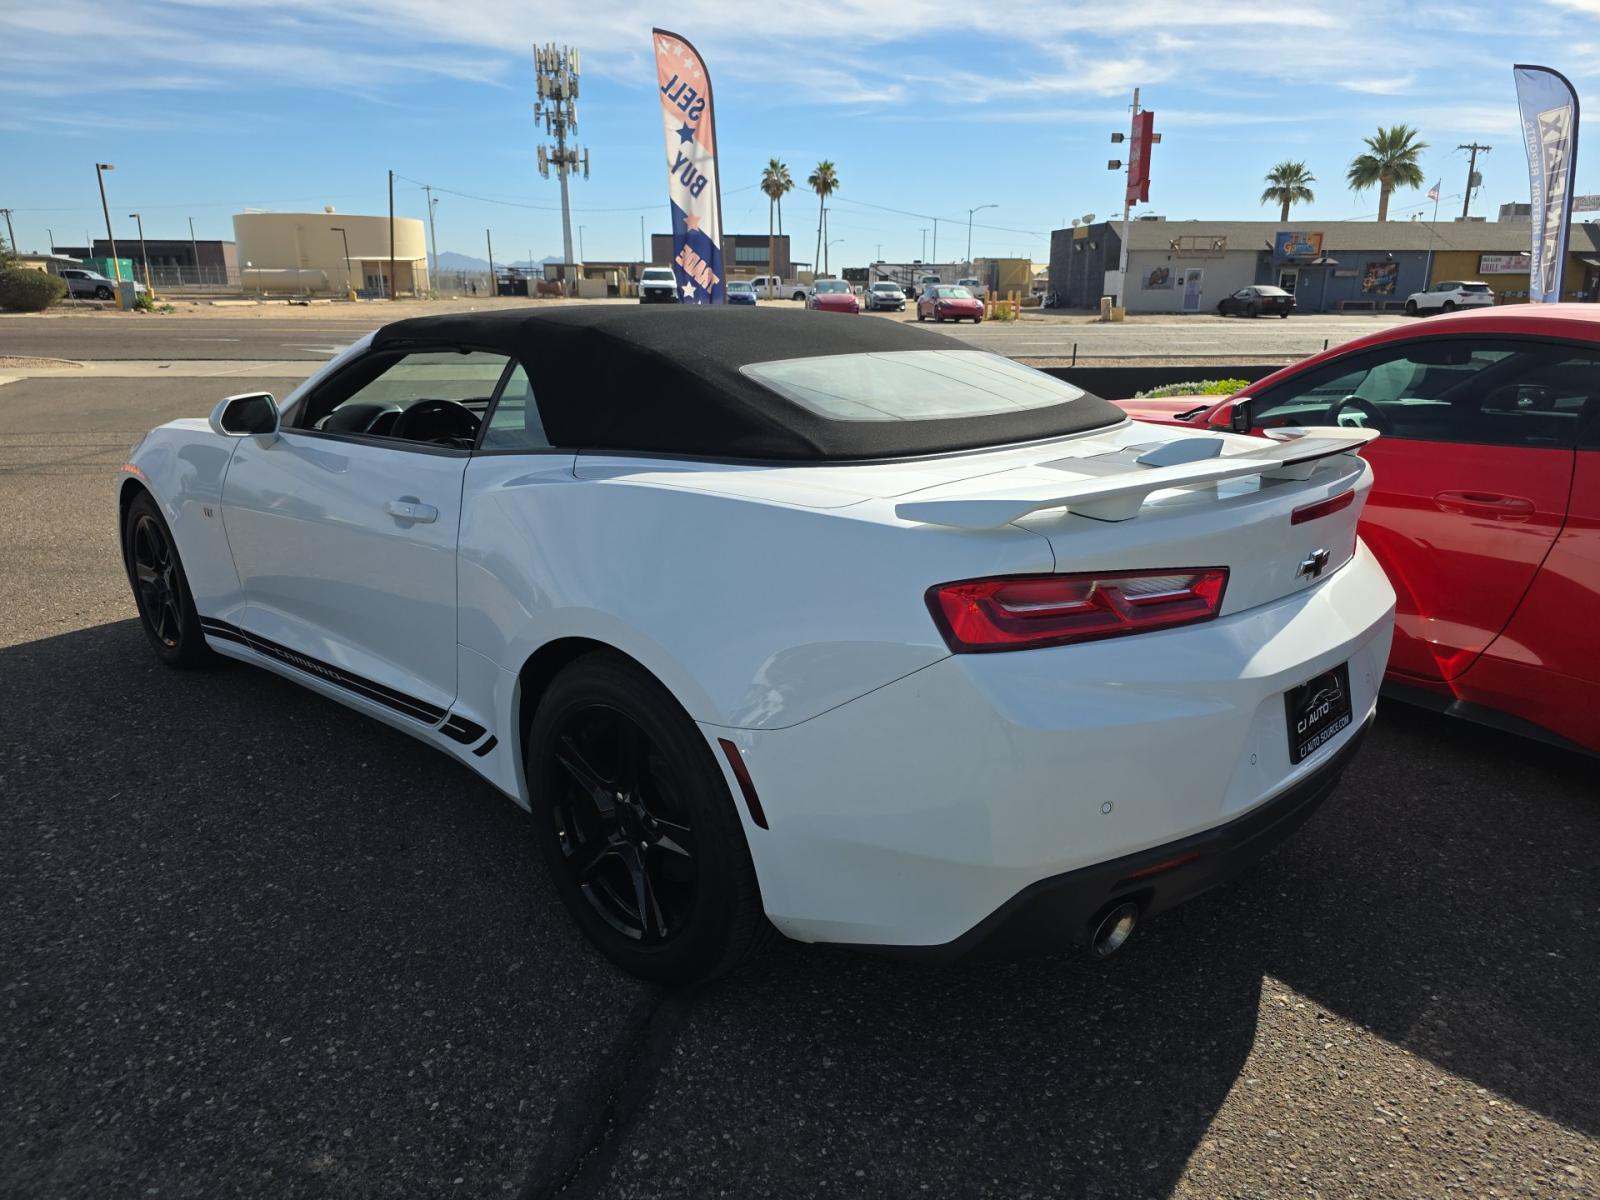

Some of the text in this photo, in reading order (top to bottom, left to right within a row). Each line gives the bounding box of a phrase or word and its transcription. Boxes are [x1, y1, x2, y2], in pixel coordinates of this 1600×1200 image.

[1298, 702, 1329, 734] CJ AUTO
[1300, 715, 1349, 758] CJ AUTO SOURCE.COM
